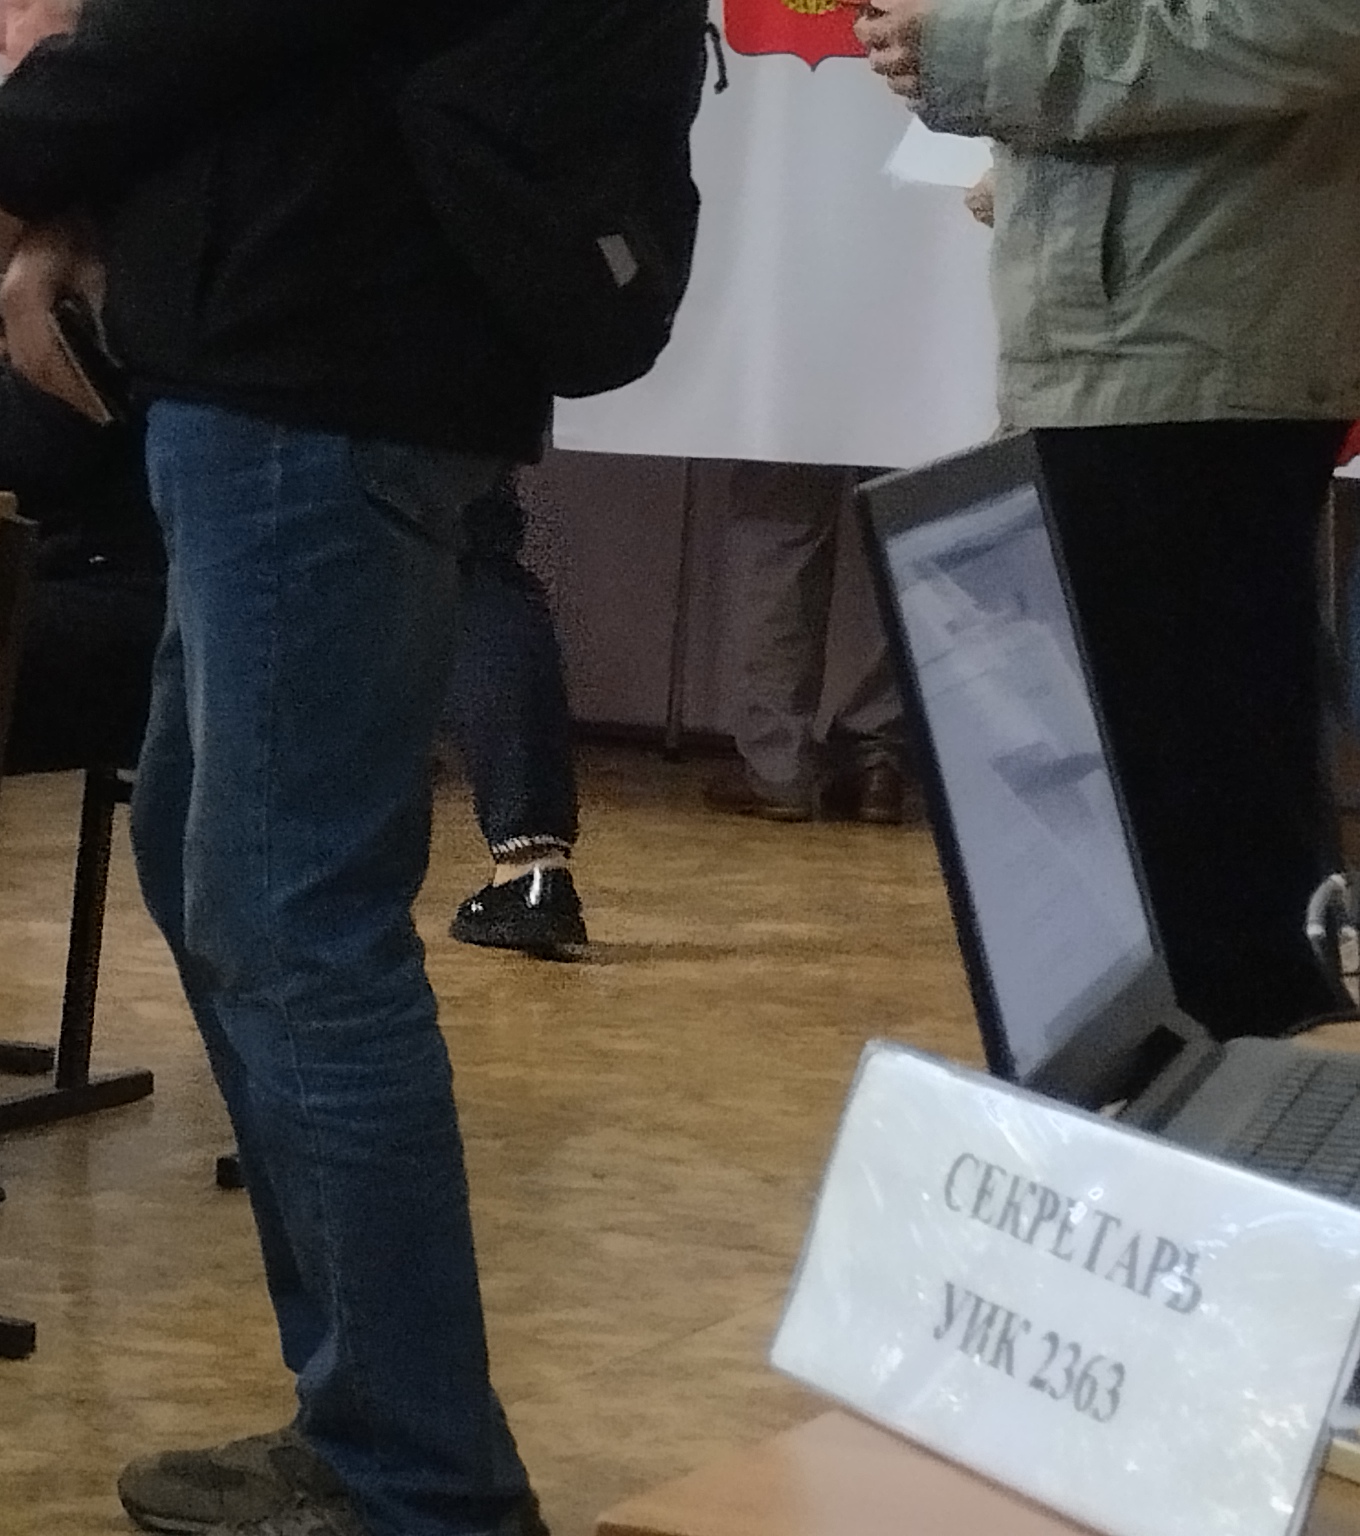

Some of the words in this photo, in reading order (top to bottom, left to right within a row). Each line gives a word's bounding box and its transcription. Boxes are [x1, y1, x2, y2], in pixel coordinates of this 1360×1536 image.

[944, 1151, 1203, 1316] СЕКРЕТАРЬ
[932, 1280, 1032, 1378] УИК
[1028, 1330, 1126, 1424] 2363
